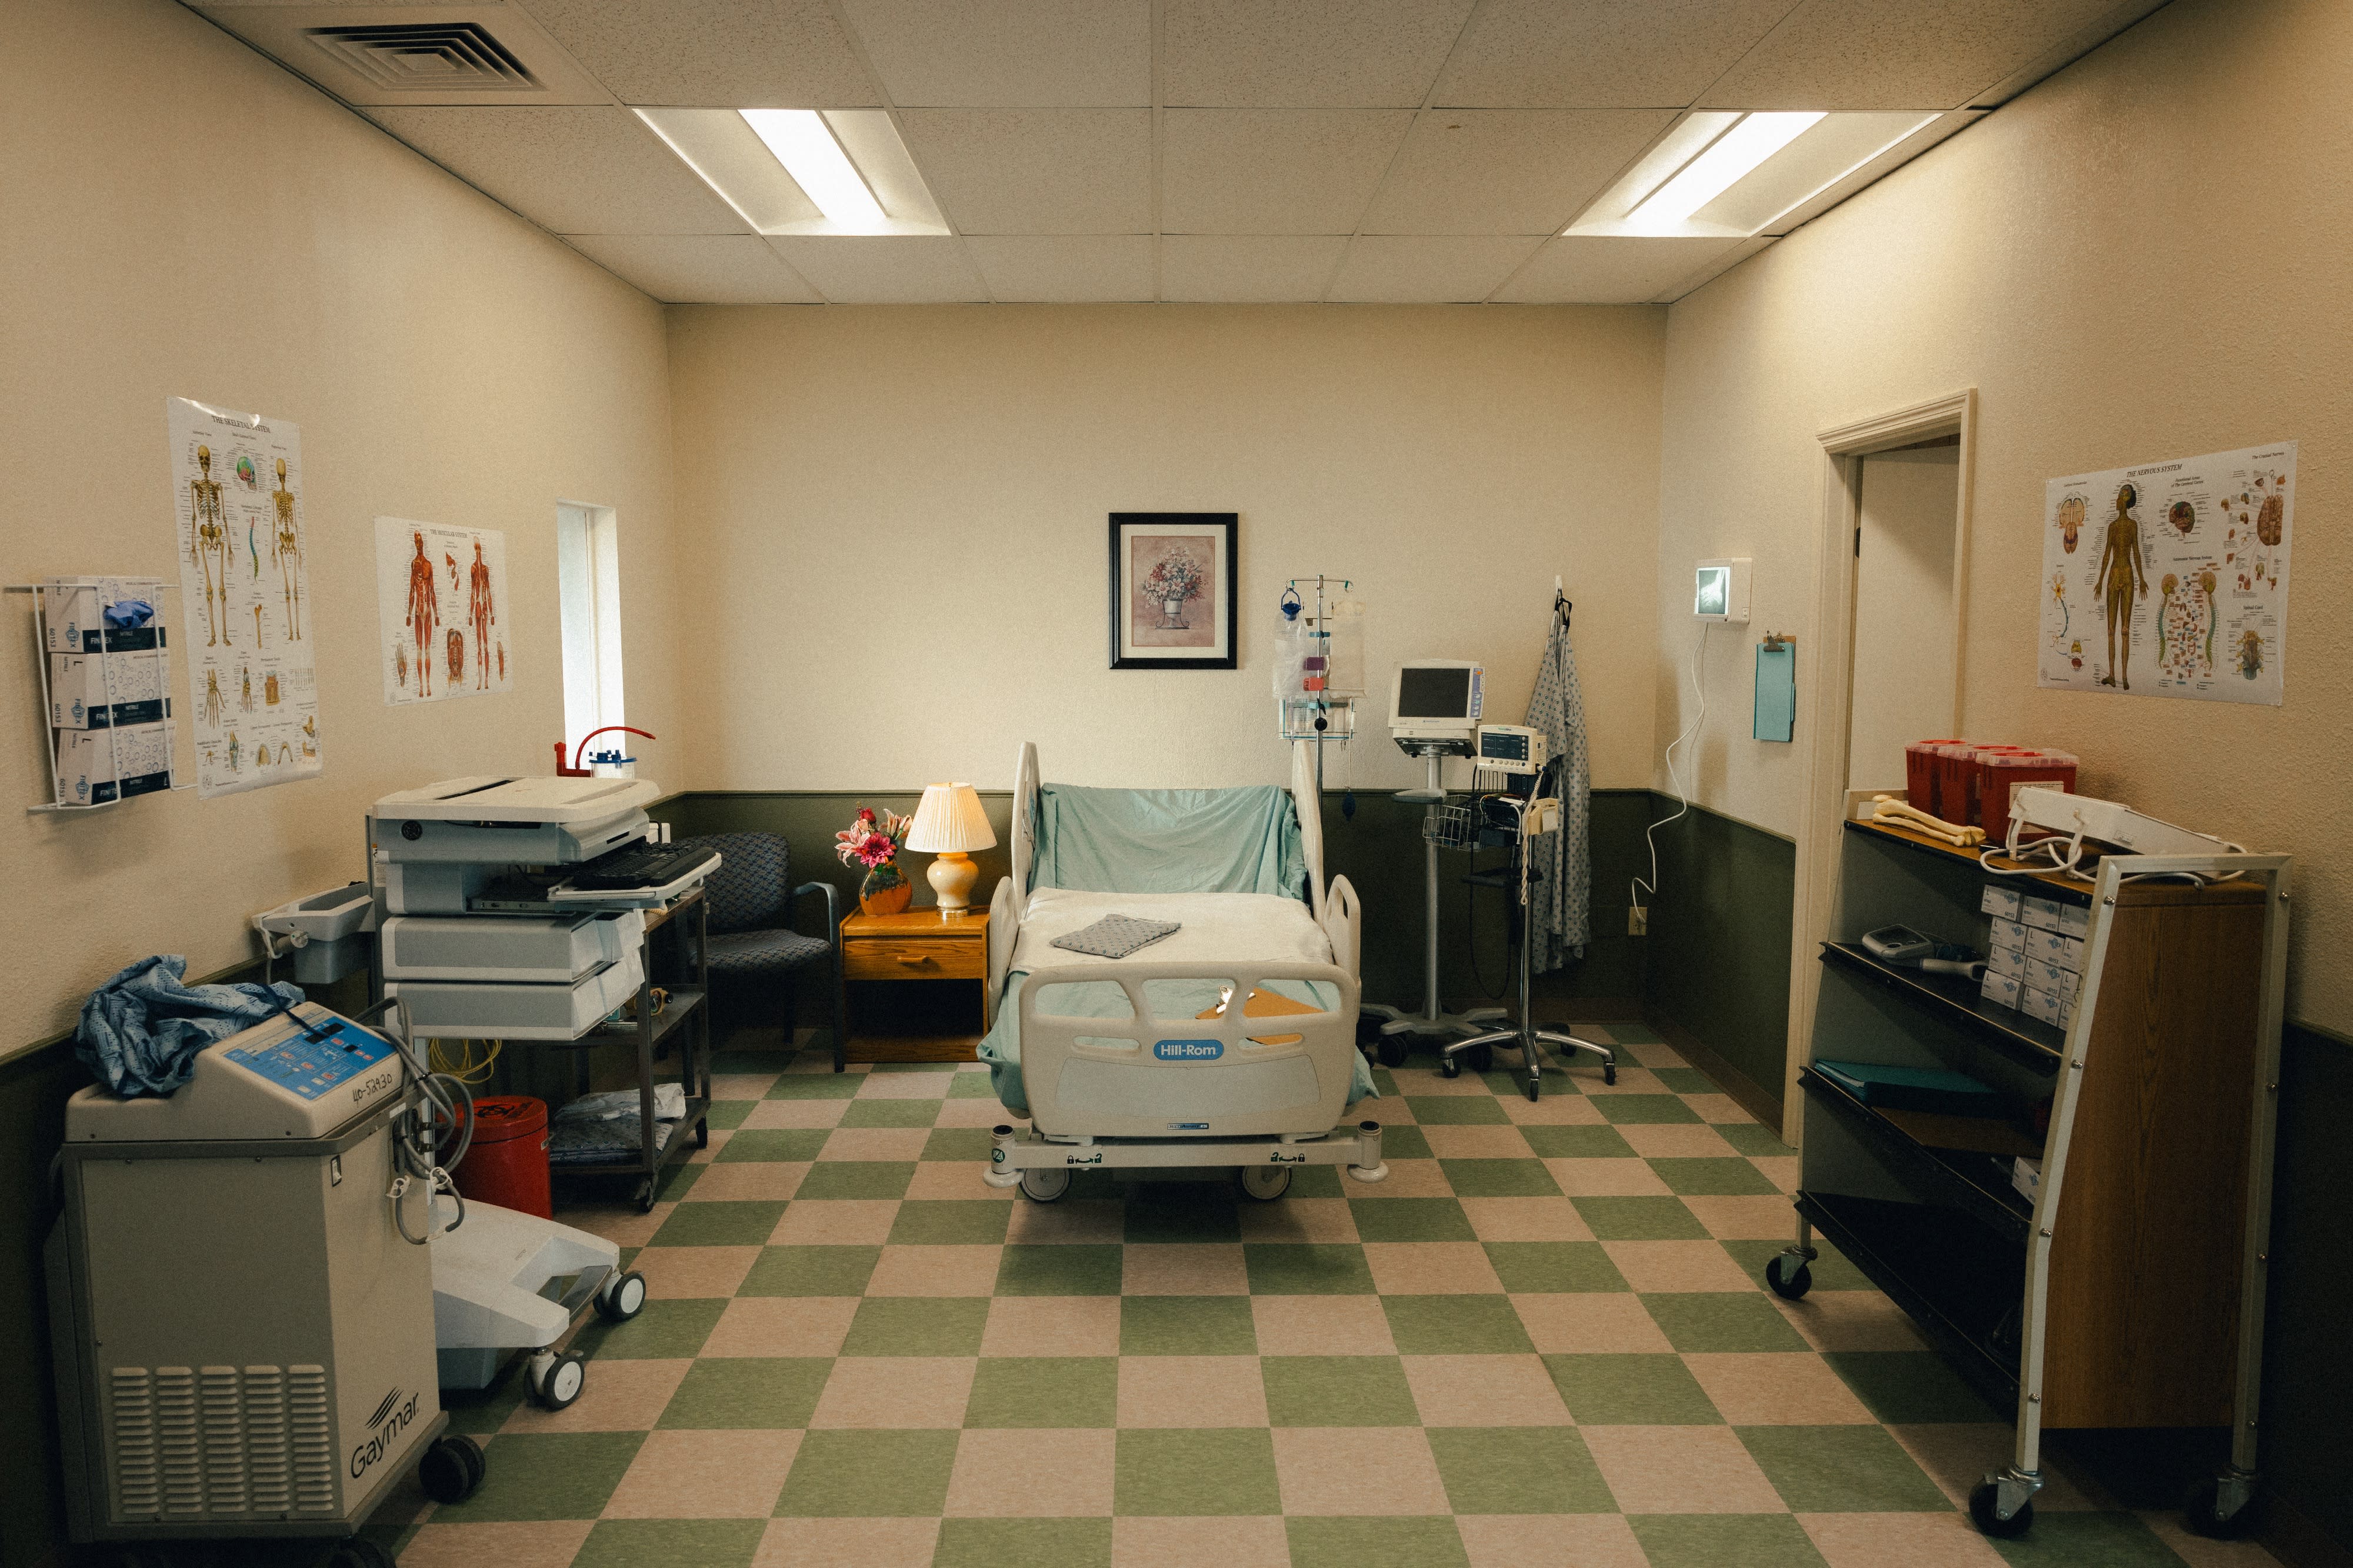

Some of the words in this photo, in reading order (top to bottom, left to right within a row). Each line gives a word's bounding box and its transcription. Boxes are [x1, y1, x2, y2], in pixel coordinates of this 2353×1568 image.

[212, 416, 224, 424] THE
[224, 418, 251, 430] SKELETAL
[2137, 467, 2161, 476] NERVOUS
[2161, 464, 2182, 473] SYSTEM
[164, 777, 168, 786] L
[1161, 1044, 1216, 1056] Hill-Rom
[351, 1392, 418, 1479] Gaymar
